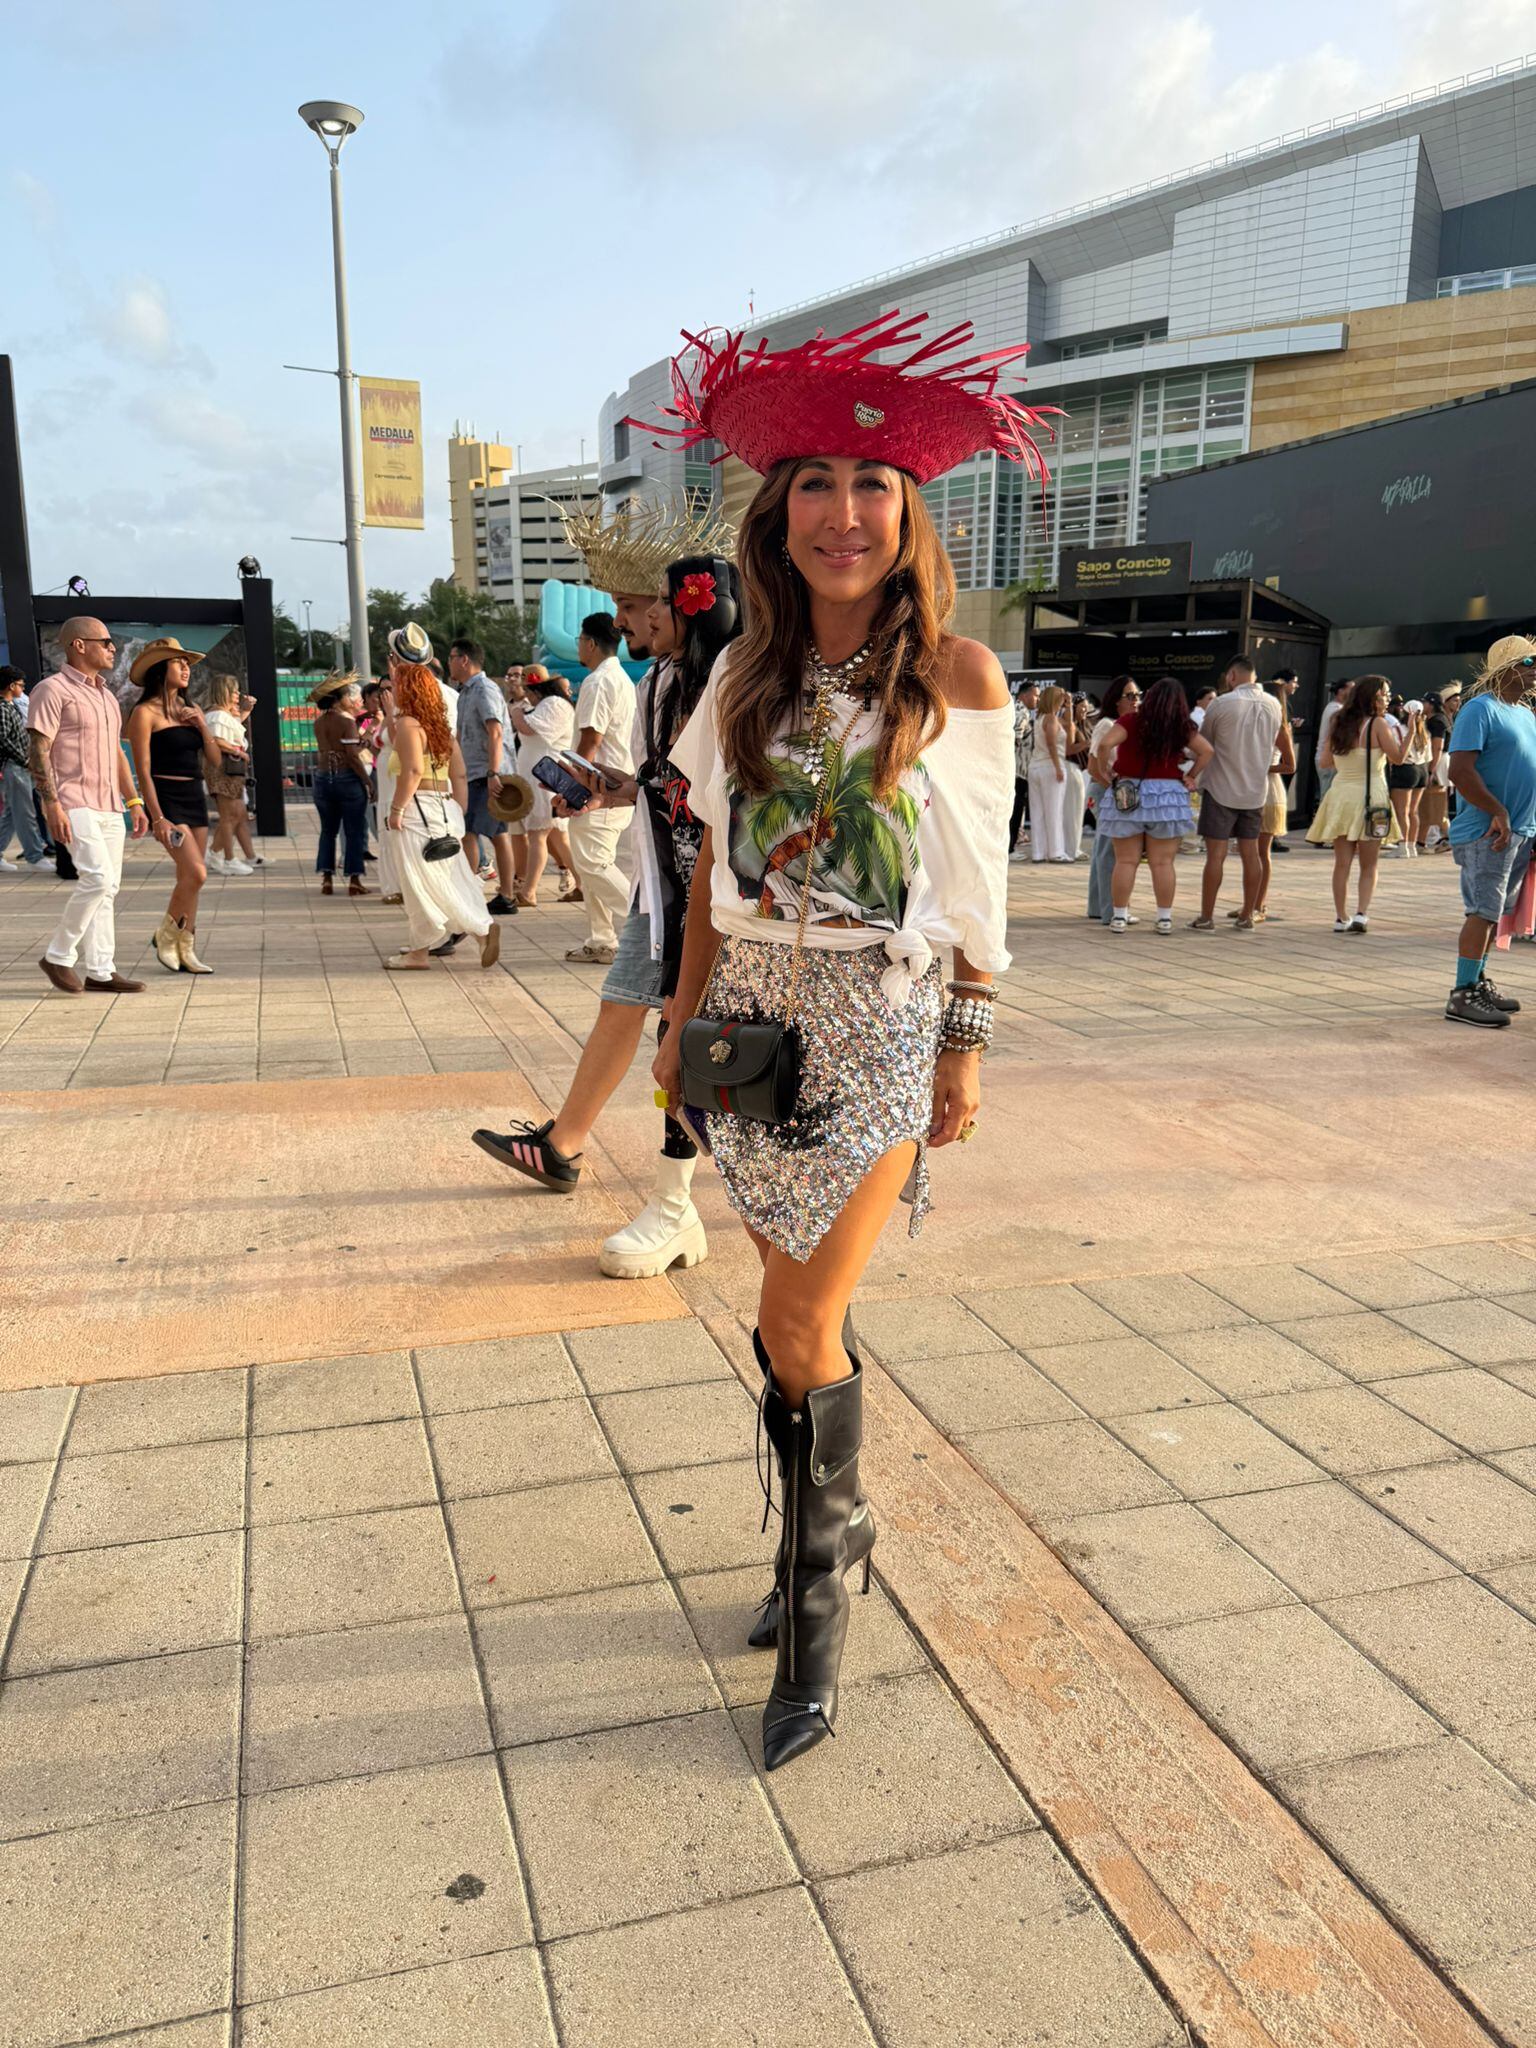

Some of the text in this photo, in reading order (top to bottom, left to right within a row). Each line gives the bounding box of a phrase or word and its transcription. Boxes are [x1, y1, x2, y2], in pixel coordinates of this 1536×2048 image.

[855, 403, 882, 418] Puerto
[856, 411, 875, 422] Rico
[370, 426, 414, 439] MEDALLA
[1076, 557, 1172, 574] Sapo Concho
[1128, 653, 1215, 666] Sapo Concho
